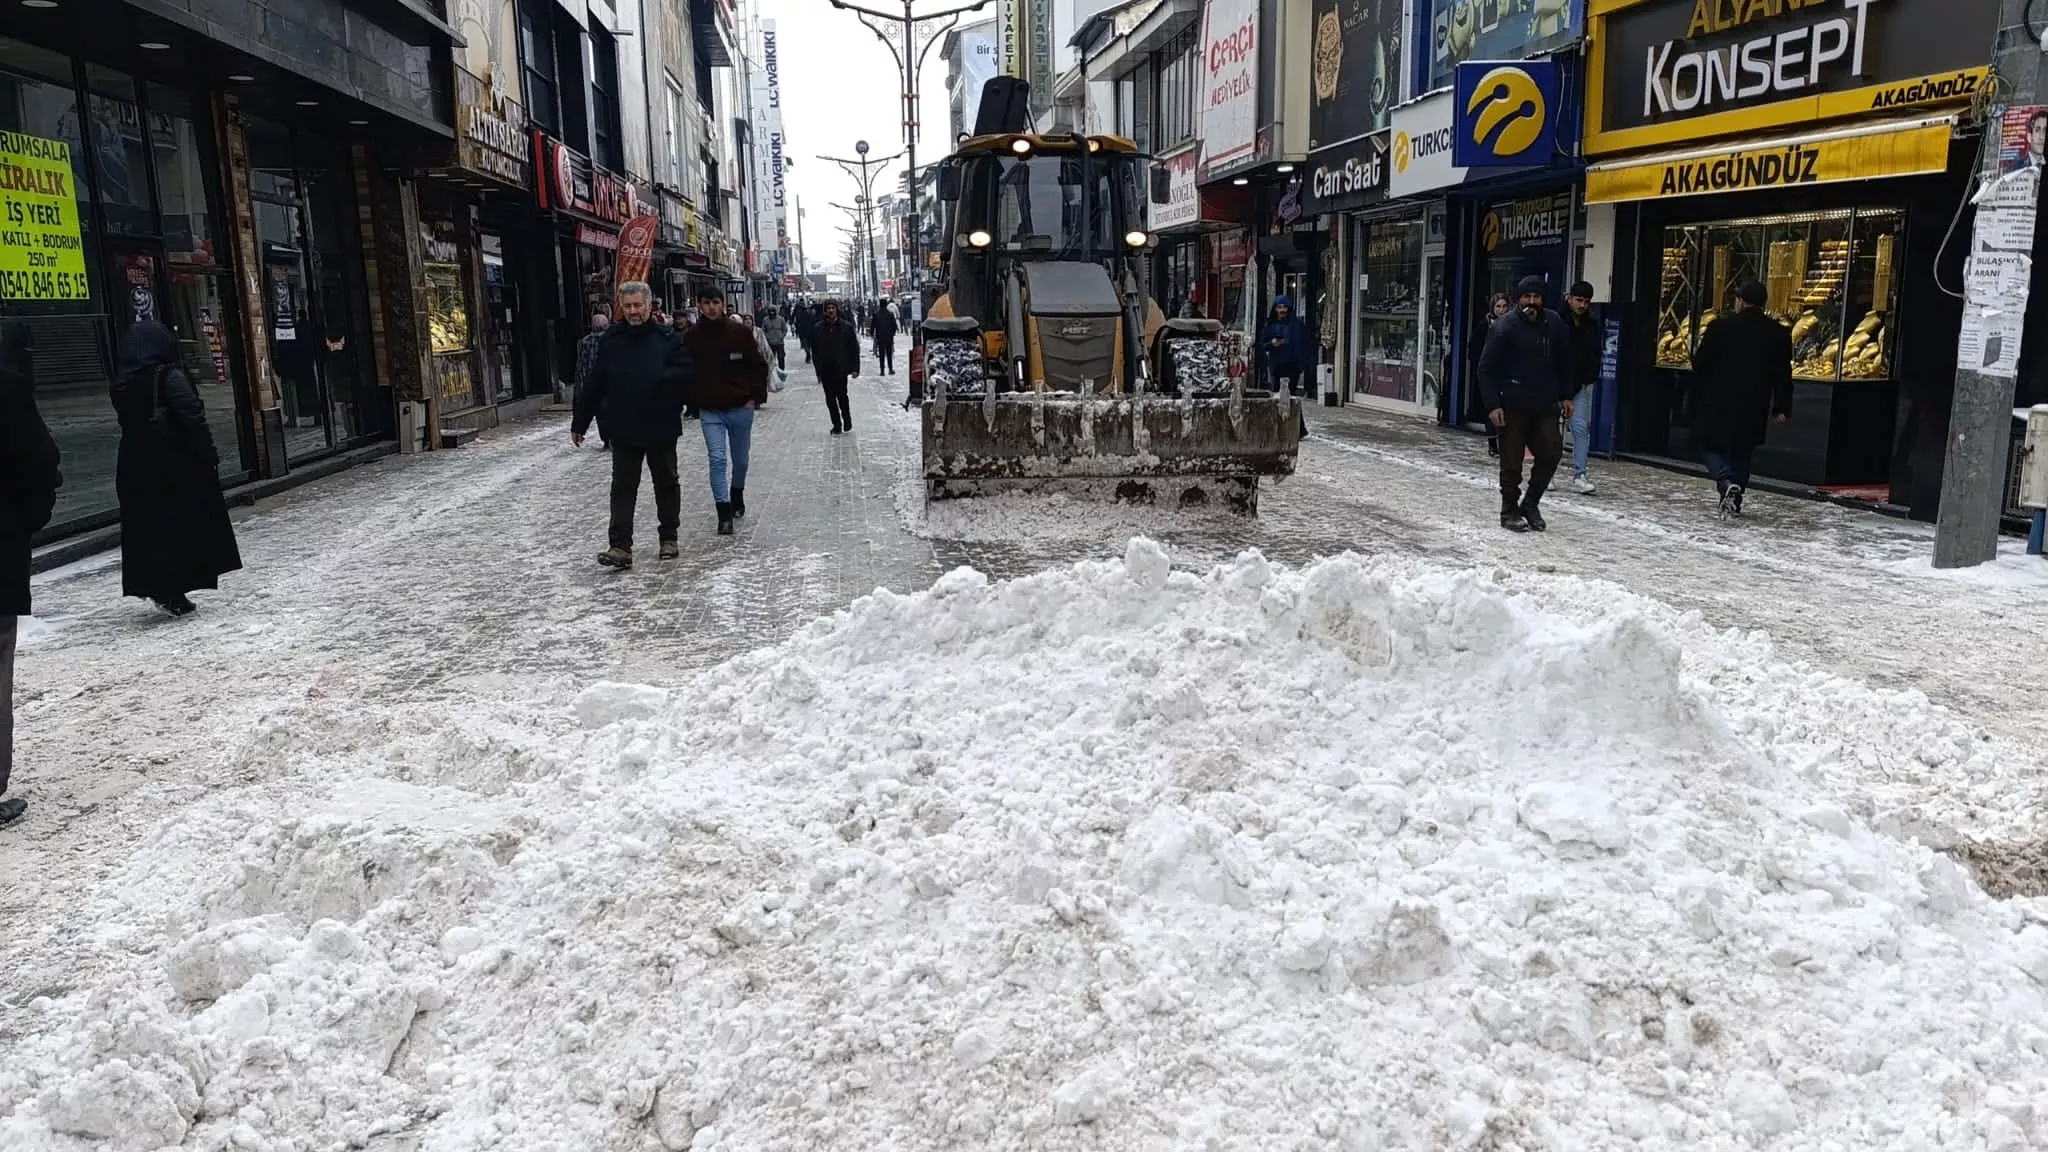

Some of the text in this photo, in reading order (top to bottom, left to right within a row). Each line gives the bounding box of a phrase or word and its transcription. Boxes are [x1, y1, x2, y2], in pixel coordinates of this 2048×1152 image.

[1343, 9, 1369, 28] NACAR
[1872, 75, 1977, 109] AKAGÜNDÜZ
[1313, 152, 1381, 199] Can Saat
[1660, 146, 1819, 195] AKAGÜNDÜZ
[6, 196, 62, 227] İŞ YERİ
[1502, 211, 1563, 240] TURKCELL
[2, 231, 31, 247] KATLI
[43, 234, 81, 249] BODRUM
[28, 252, 45, 266] 250
[32, 272, 54, 299] 846
[57, 274, 72, 298] 65
[73, 273, 87, 299] 15
